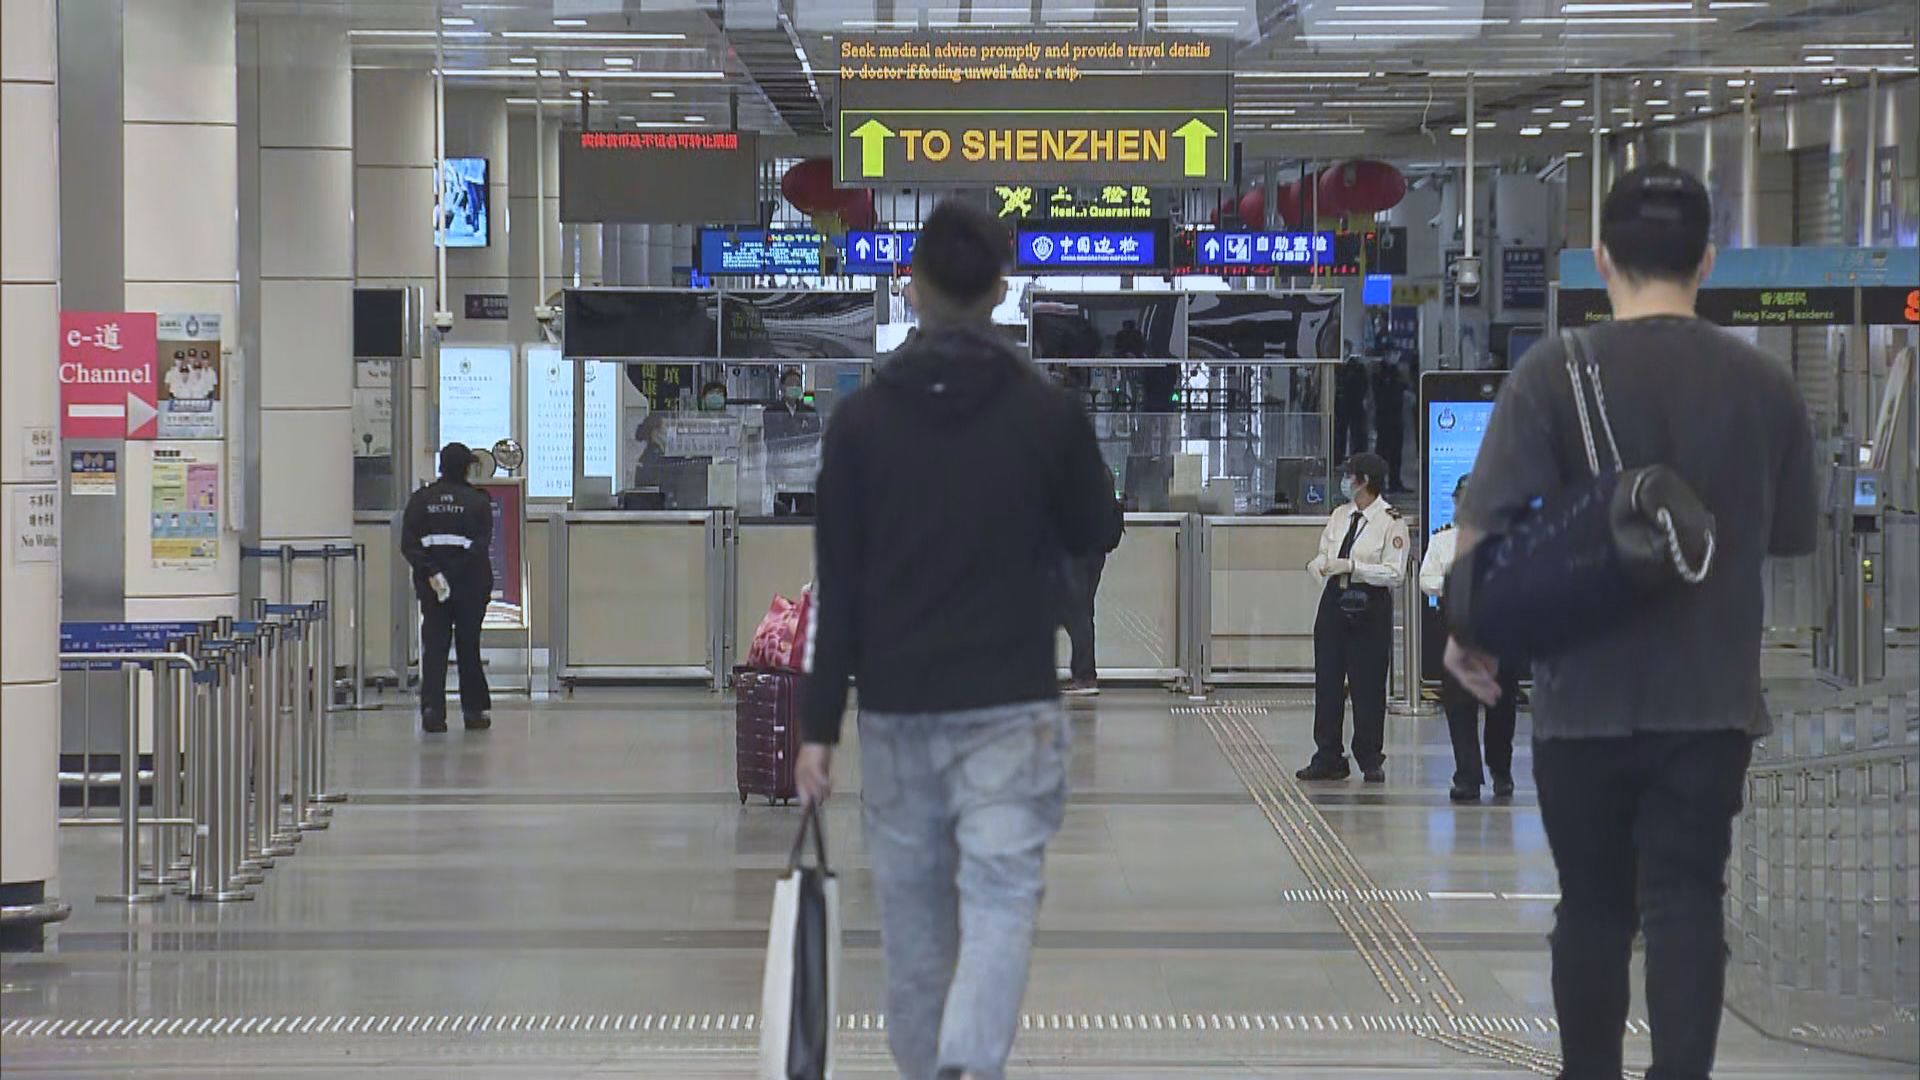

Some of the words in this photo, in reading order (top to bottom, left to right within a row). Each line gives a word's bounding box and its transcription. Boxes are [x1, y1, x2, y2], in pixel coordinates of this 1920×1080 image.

[841, 42, 876, 58] Seek
[879, 42, 931, 58] medical
[934, 42, 977, 58] advice
[981, 42, 1041, 61] promptly
[1045, 42, 1070, 58] and
[1073, 42, 1124, 61] provide
[1127, 42, 1165, 58] travel
[1169, 42, 1211, 58] details
[841, 64, 854, 80] to
[858, 64, 904, 80] doctor
[906, 64, 917, 80] if
[918, 64, 961, 82] feeling
[965, 64, 1008, 80] unwell
[1011, 64, 1042, 80] after
[1045, 68, 1055, 80] a
[1057, 64, 1083, 82] trip.
[899, 129, 952, 162] TO
[961, 128, 1167, 162] SHENZHEN
[1089, 205, 1151, 218] Quarantine
[1060, 235, 1139, 254] 中国边检
[1732, 309, 1759, 321] Hong
[1761, 309, 1787, 321] Kong
[1788, 308, 1834, 320] Residents
[58, 362, 153, 385] Channel
